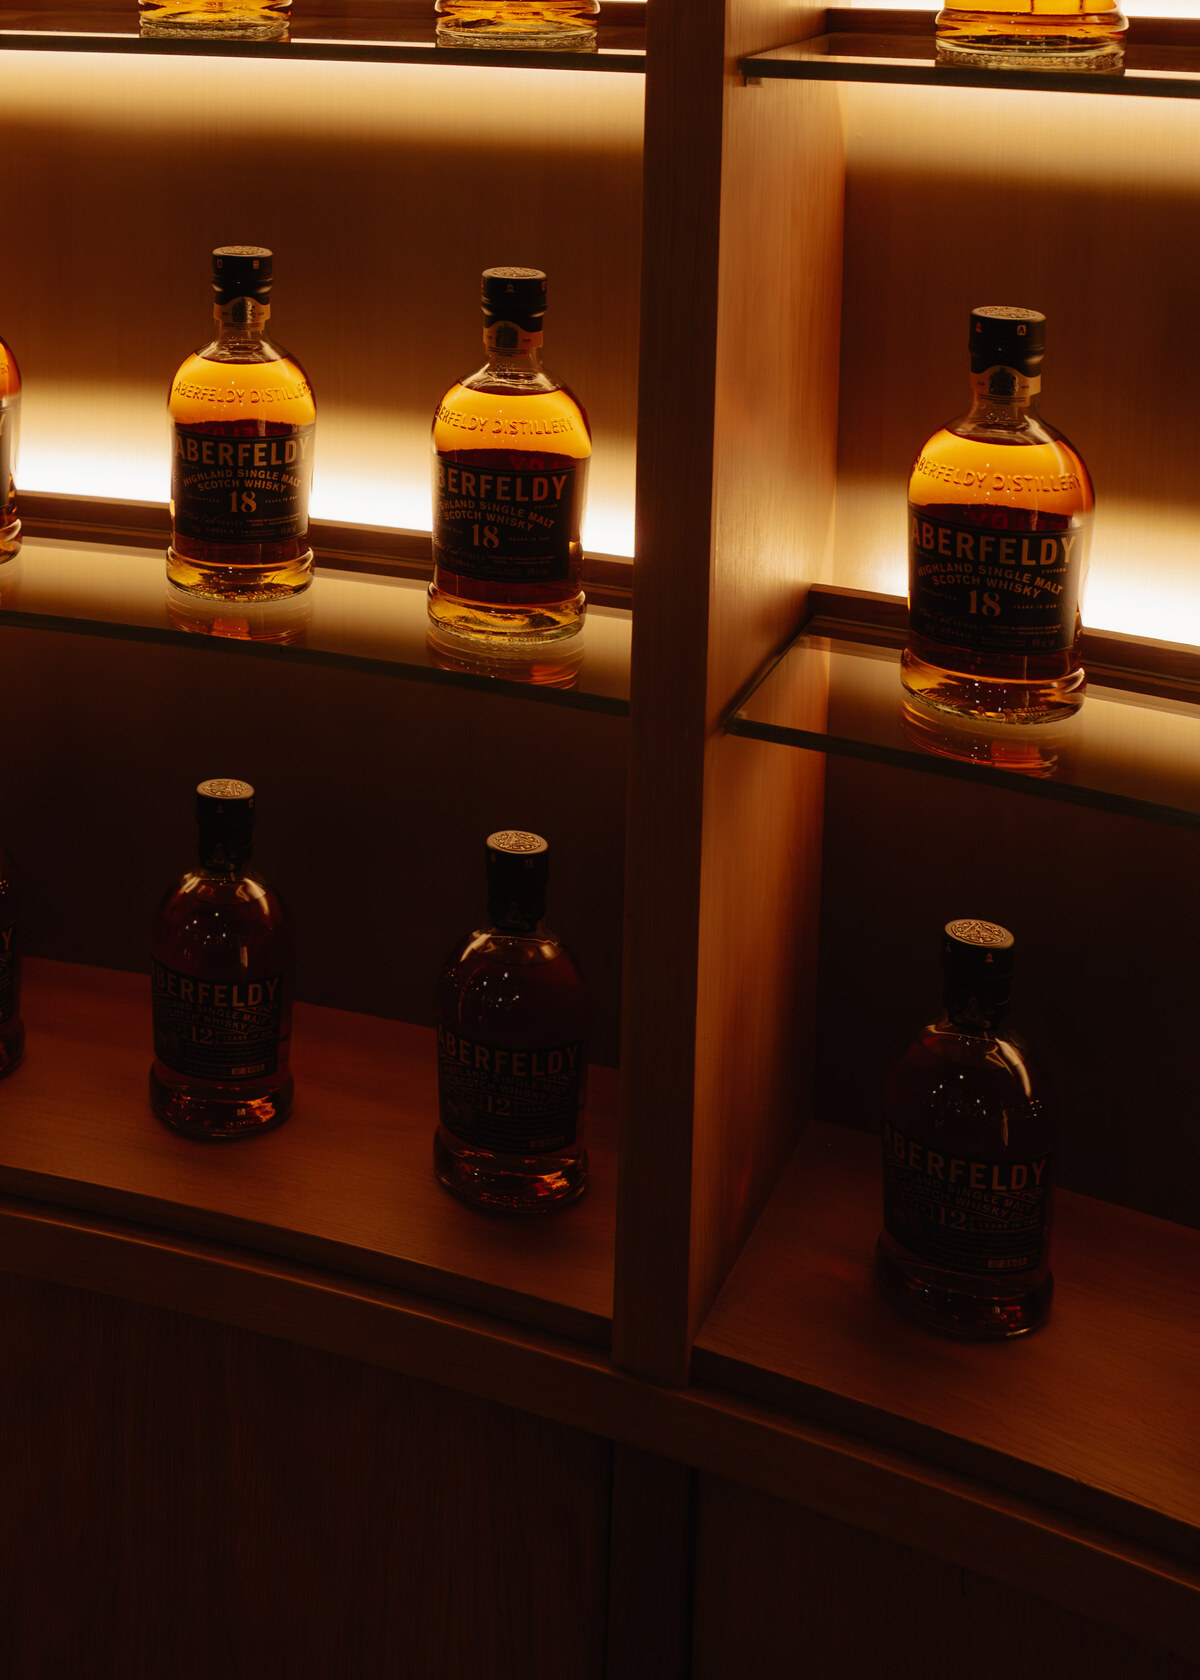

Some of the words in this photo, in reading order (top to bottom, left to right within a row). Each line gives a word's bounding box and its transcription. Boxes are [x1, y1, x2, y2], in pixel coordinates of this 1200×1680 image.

[491, 416, 575, 436] DISTILLERY
[177, 435, 309, 466] ABERFELDY
[183, 470, 233, 487] HIGHLAND
[237, 469, 279, 480] SINGLE
[198, 481, 239, 492] SCOTCH
[245, 480, 287, 493] WHISKY
[228, 490, 257, 513] 18
[480, 501, 525, 517] SINGLE
[528, 512, 556, 528] MALT
[486, 512, 534, 531] WHISKY
[471, 523, 500, 548] 18
[912, 518, 1076, 566] ABERFELDY
[931, 574, 981, 587] SCOTCH
[986, 577, 1042, 598] WHISKY
[977, 566, 1032, 585] SINGLE
[1034, 577, 1063, 596] MALT
[968, 590, 1002, 616] 18
[191, 1025, 214, 1045] 12
[487, 1095, 511, 1117] 12
[884, 1120, 1048, 1191] ABERFELDY
[947, 1183, 999, 1205] SINGLE
[939, 1206, 968, 1231] 12
